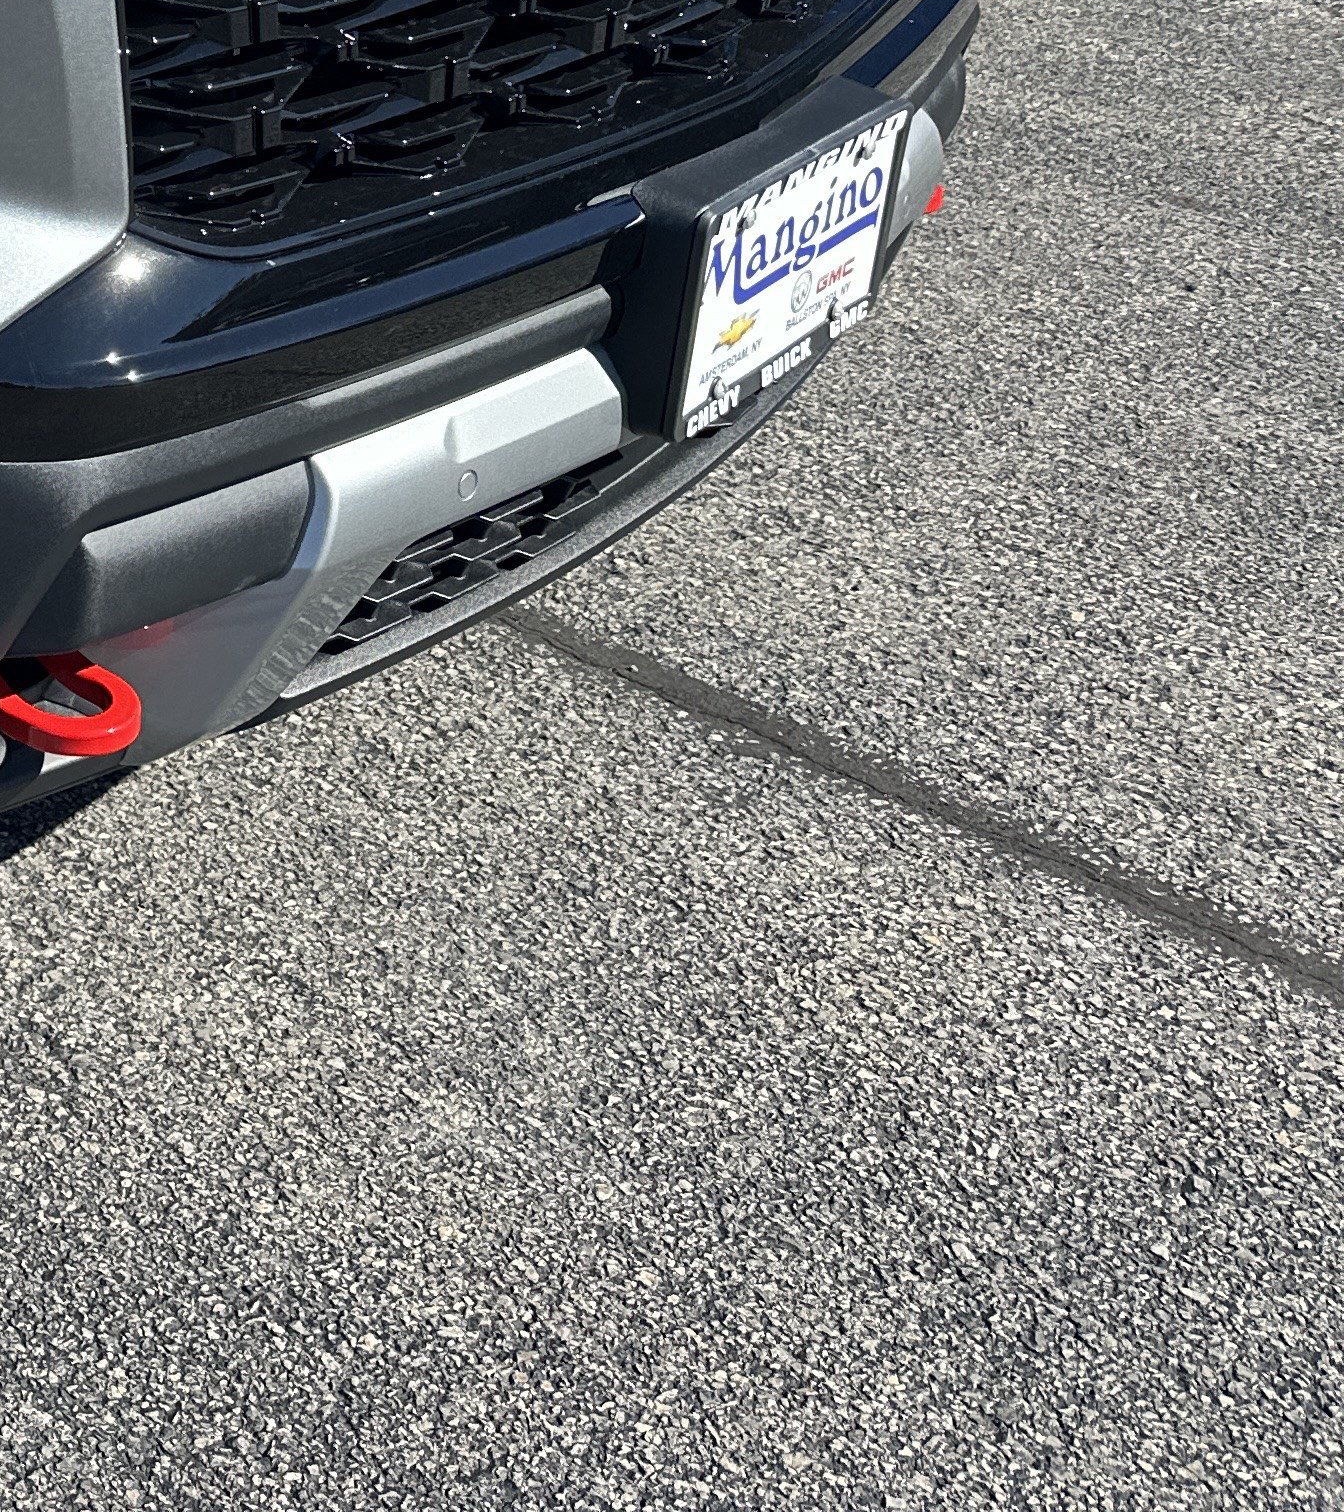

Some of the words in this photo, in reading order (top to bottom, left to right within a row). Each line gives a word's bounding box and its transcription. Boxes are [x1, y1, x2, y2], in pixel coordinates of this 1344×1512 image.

[704, 166, 884, 304] Mangino
[815, 255, 857, 294] GMC
[686, 384, 741, 438] CHEVY
[761, 336, 812, 388] BUICK
[829, 300, 869, 339] GMC
[751, 337, 763, 353] NY
